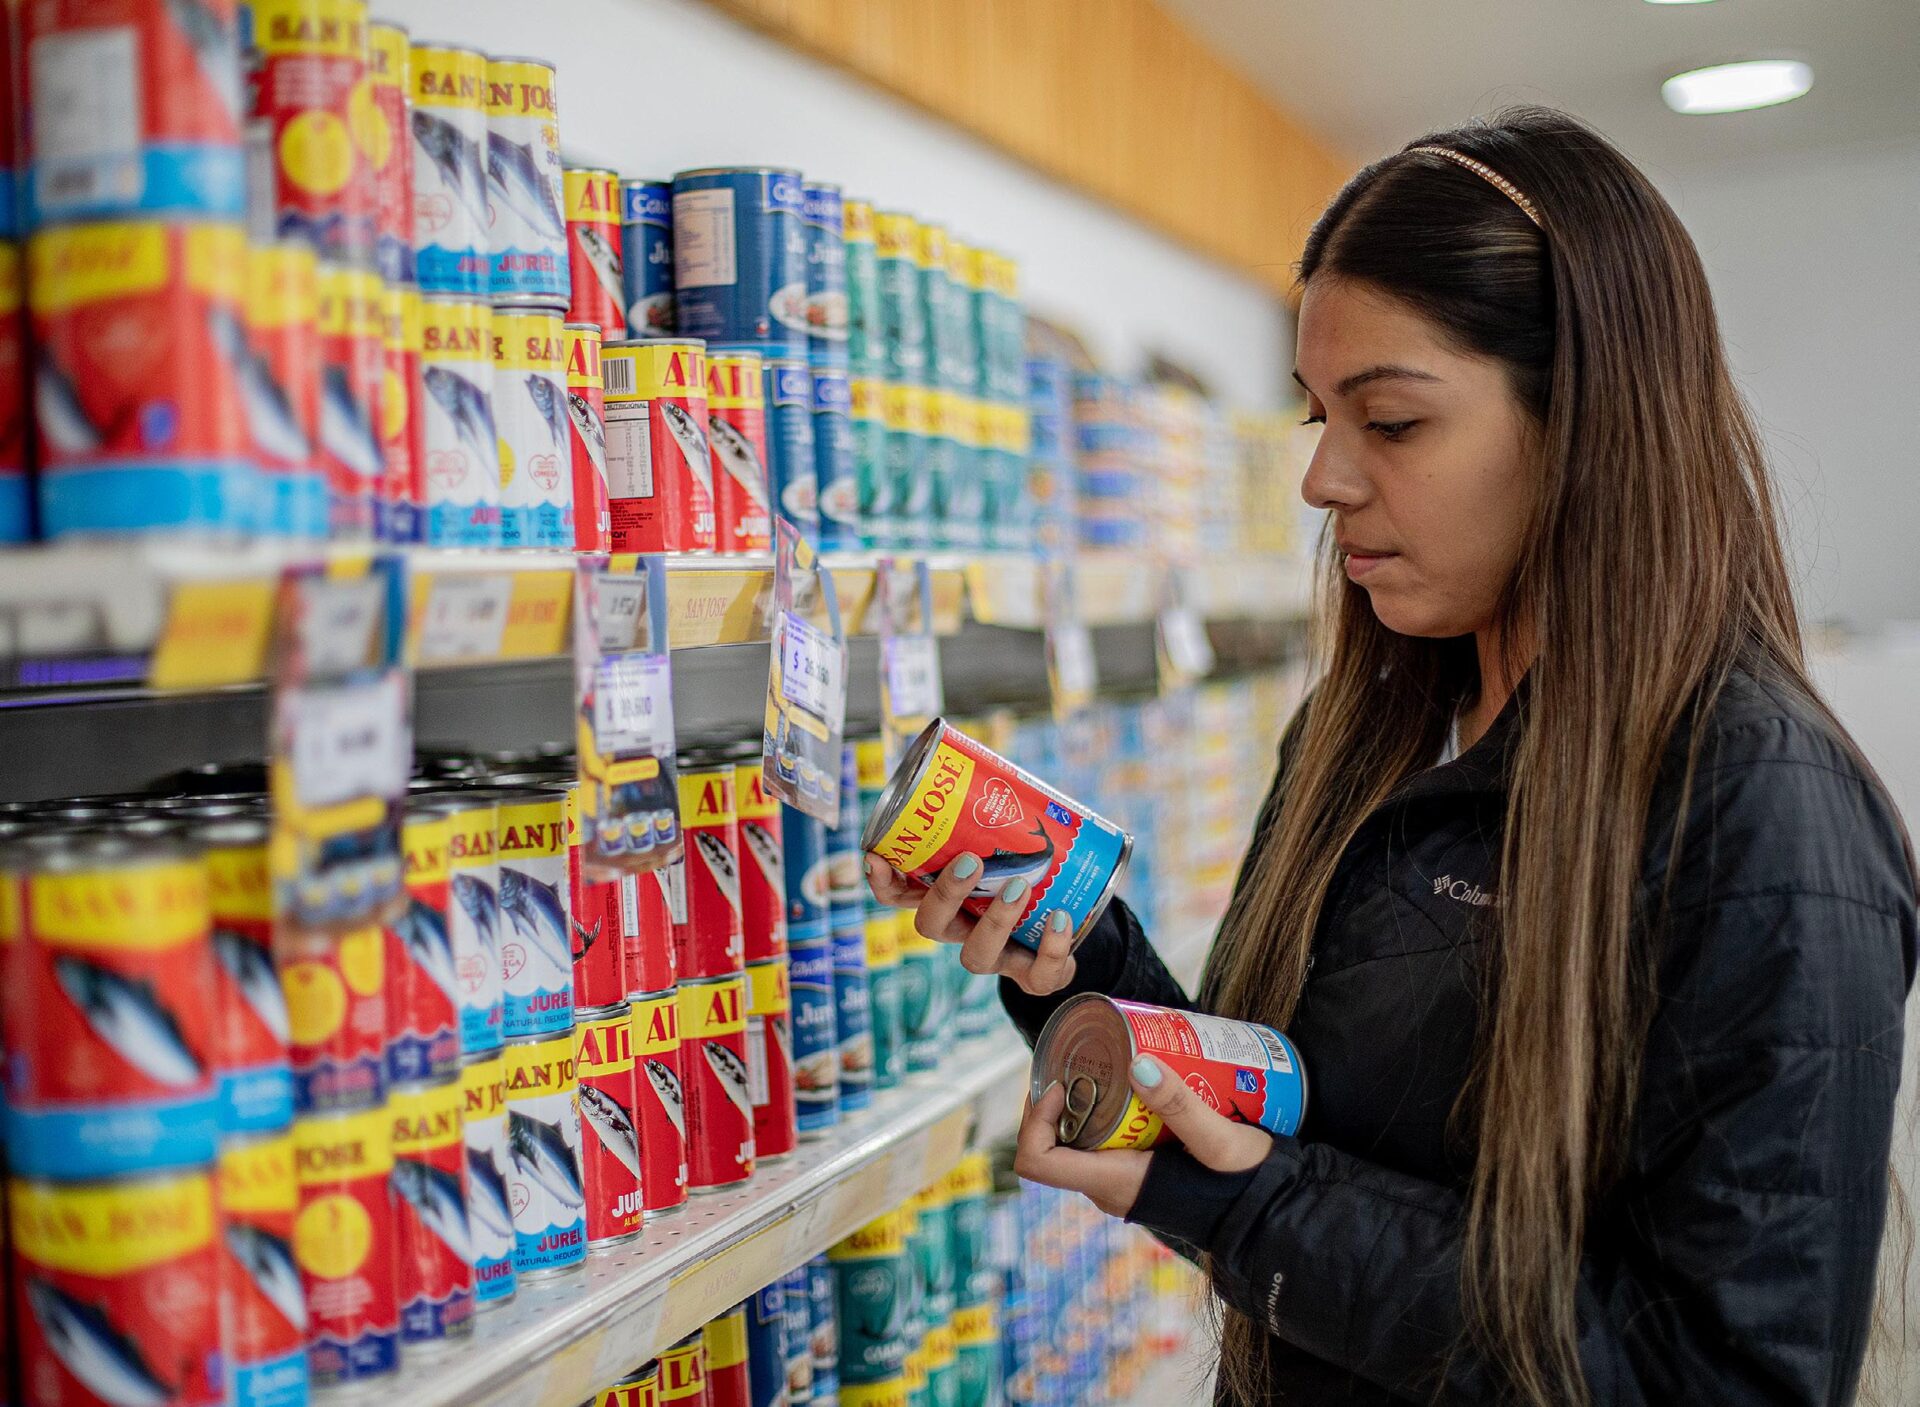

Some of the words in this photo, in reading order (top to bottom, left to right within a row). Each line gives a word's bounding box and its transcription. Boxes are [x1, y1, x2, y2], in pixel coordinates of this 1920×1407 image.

[420, 72, 475, 98] SAN
[423, 326, 480, 352] SAN
[526, 336, 565, 362] SAN
[882, 826, 923, 867] SAN
[913, 754, 966, 832] JOSÉ
[988, 793, 1009, 825] OMEGA
[500, 825, 545, 850] AN
[506, 1063, 552, 1091] AN
[536, 1228, 582, 1253] JUREL
